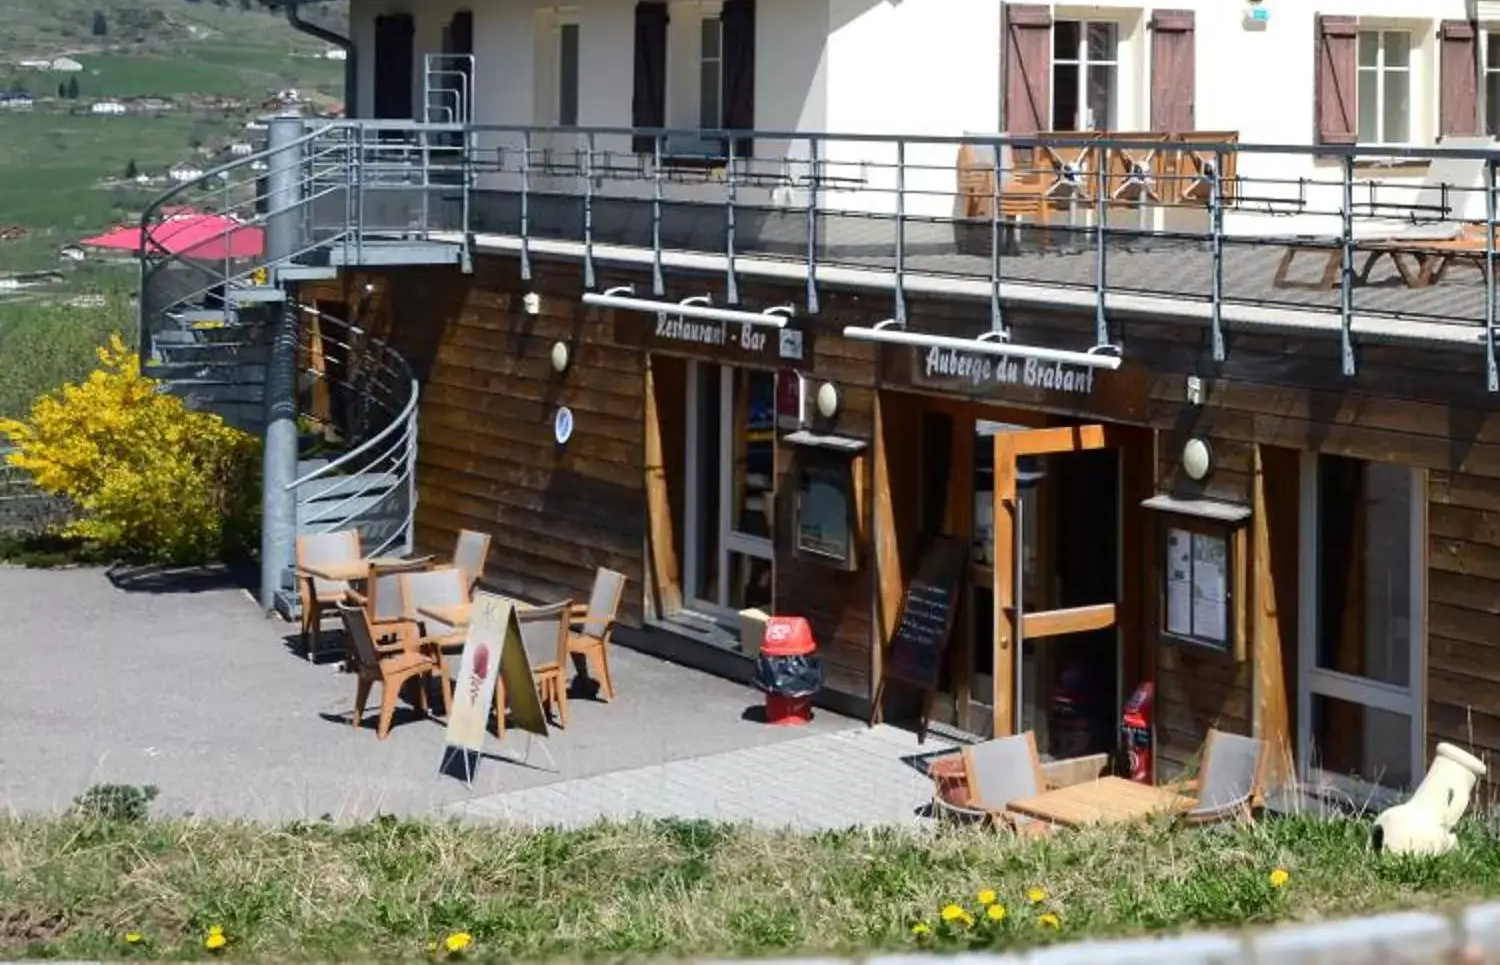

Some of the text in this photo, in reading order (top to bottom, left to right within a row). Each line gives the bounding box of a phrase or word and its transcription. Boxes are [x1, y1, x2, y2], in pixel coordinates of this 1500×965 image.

[655, 311, 727, 347] Restaurant
[740, 322, 766, 352] Bar
[925, 346, 1093, 393] Auberge du Brabant
